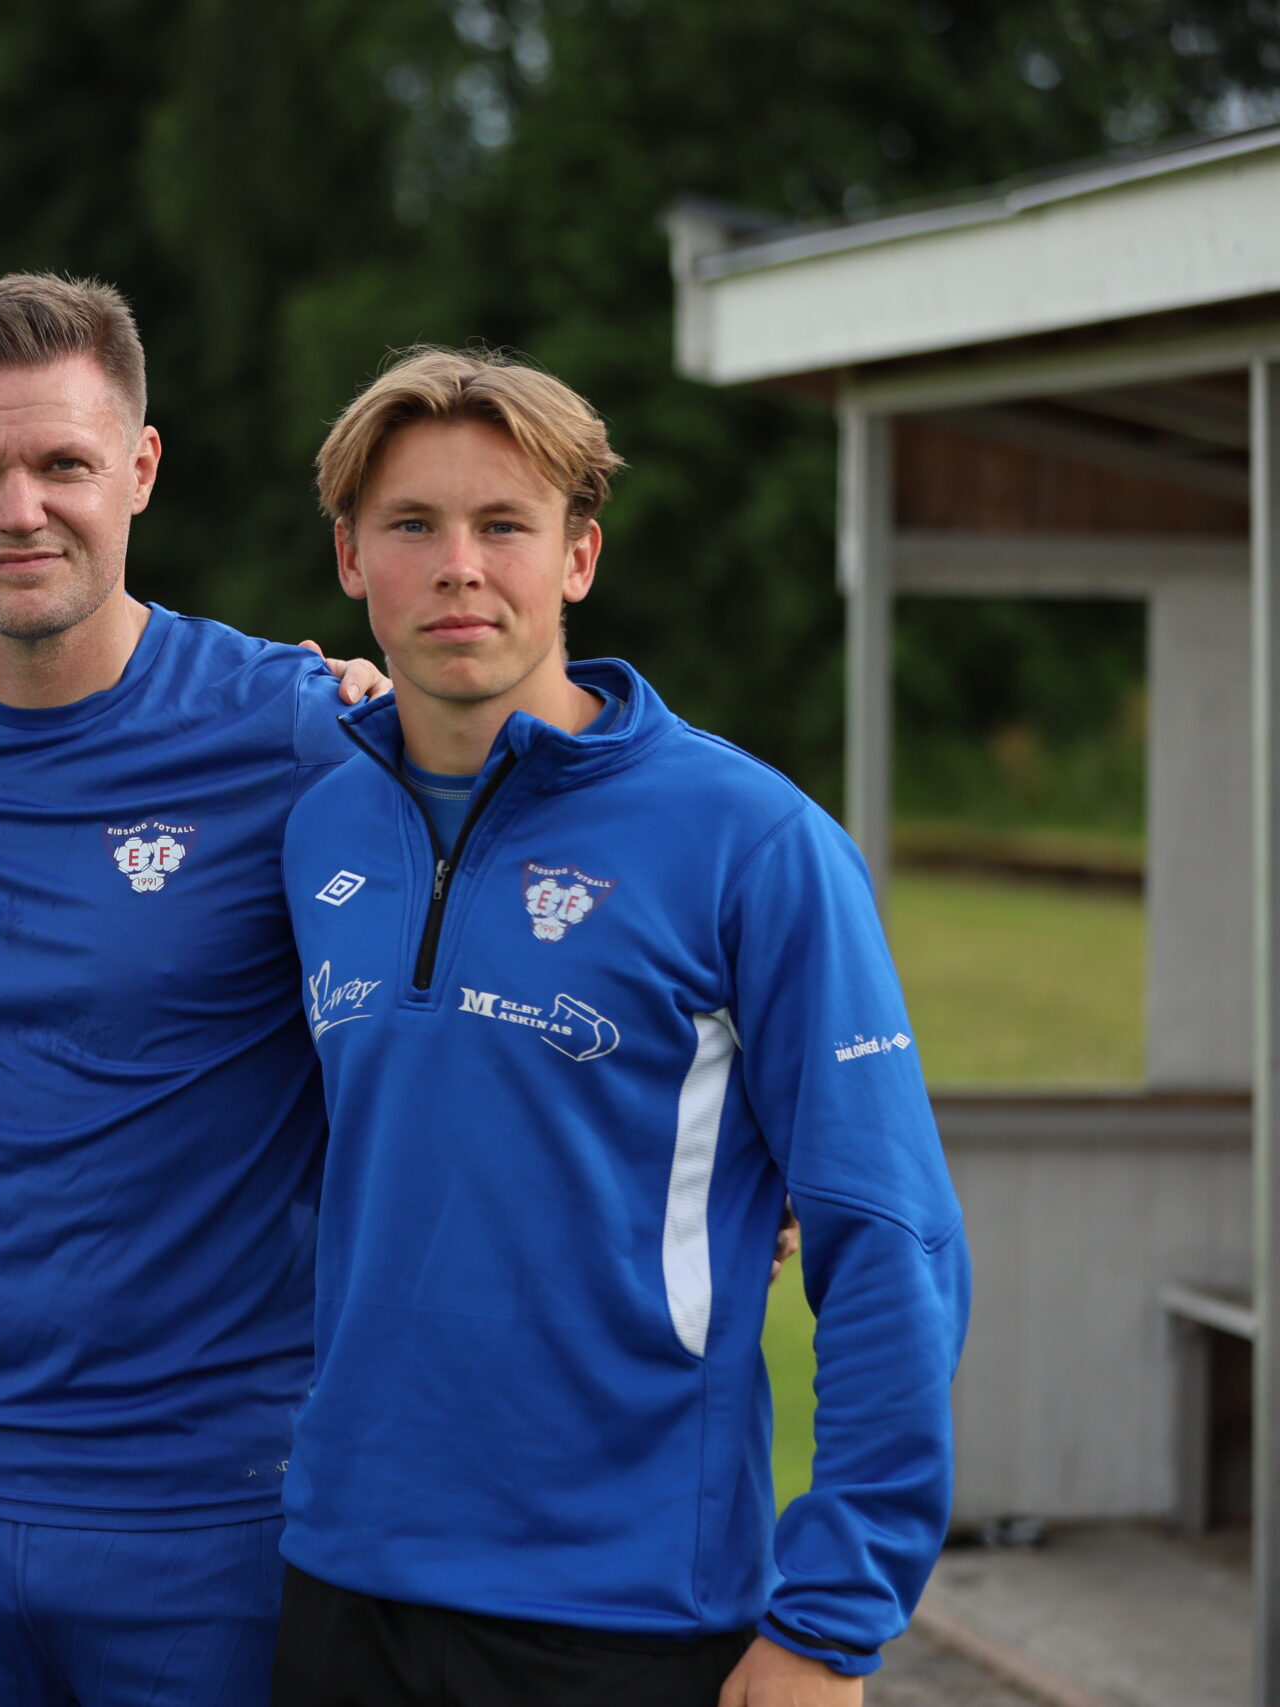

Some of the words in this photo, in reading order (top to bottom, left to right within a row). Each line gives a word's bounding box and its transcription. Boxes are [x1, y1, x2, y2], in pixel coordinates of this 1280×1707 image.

[107, 822, 148, 836] EIDSKOG
[153, 822, 195, 834] FOTBALL
[128, 848, 140, 867] E
[159, 846, 171, 866] F
[528, 863, 568, 876] EIDSKOG
[137, 877, 157, 886] 1991
[537, 889, 552, 911] E
[565, 895, 580, 915] F
[549, 1023, 572, 1036] AS
[834, 1039, 880, 1062] TAILORED
